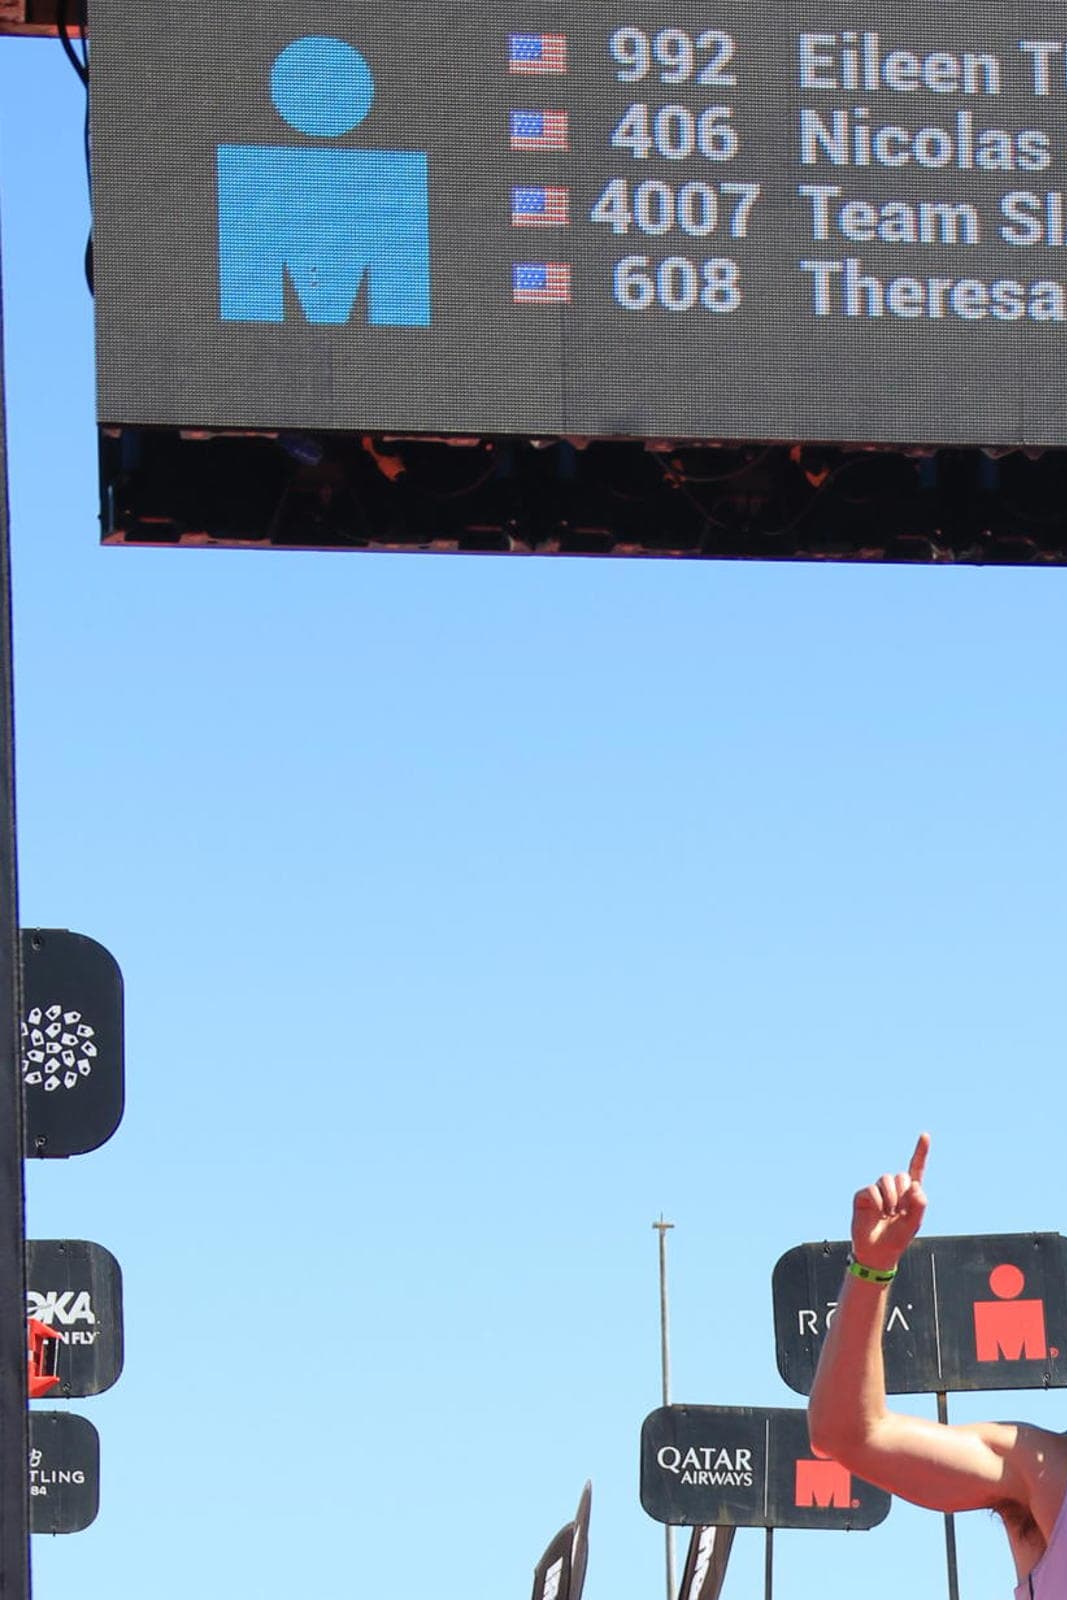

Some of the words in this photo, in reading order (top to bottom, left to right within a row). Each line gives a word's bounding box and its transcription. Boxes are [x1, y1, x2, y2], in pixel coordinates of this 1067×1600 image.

[611, 27, 736, 85] 992
[801, 32, 999, 94] Eileen
[613, 104, 737, 160] 406
[802, 108, 1050, 170] Nicolas
[592, 179, 759, 237] 4007
[801, 186, 978, 243] Team
[616, 256, 741, 312] 608
[802, 259, 1065, 320] Theresa
[657, 1446, 753, 1474] QATAR
[680, 1470, 754, 1488] AIRWAYS
